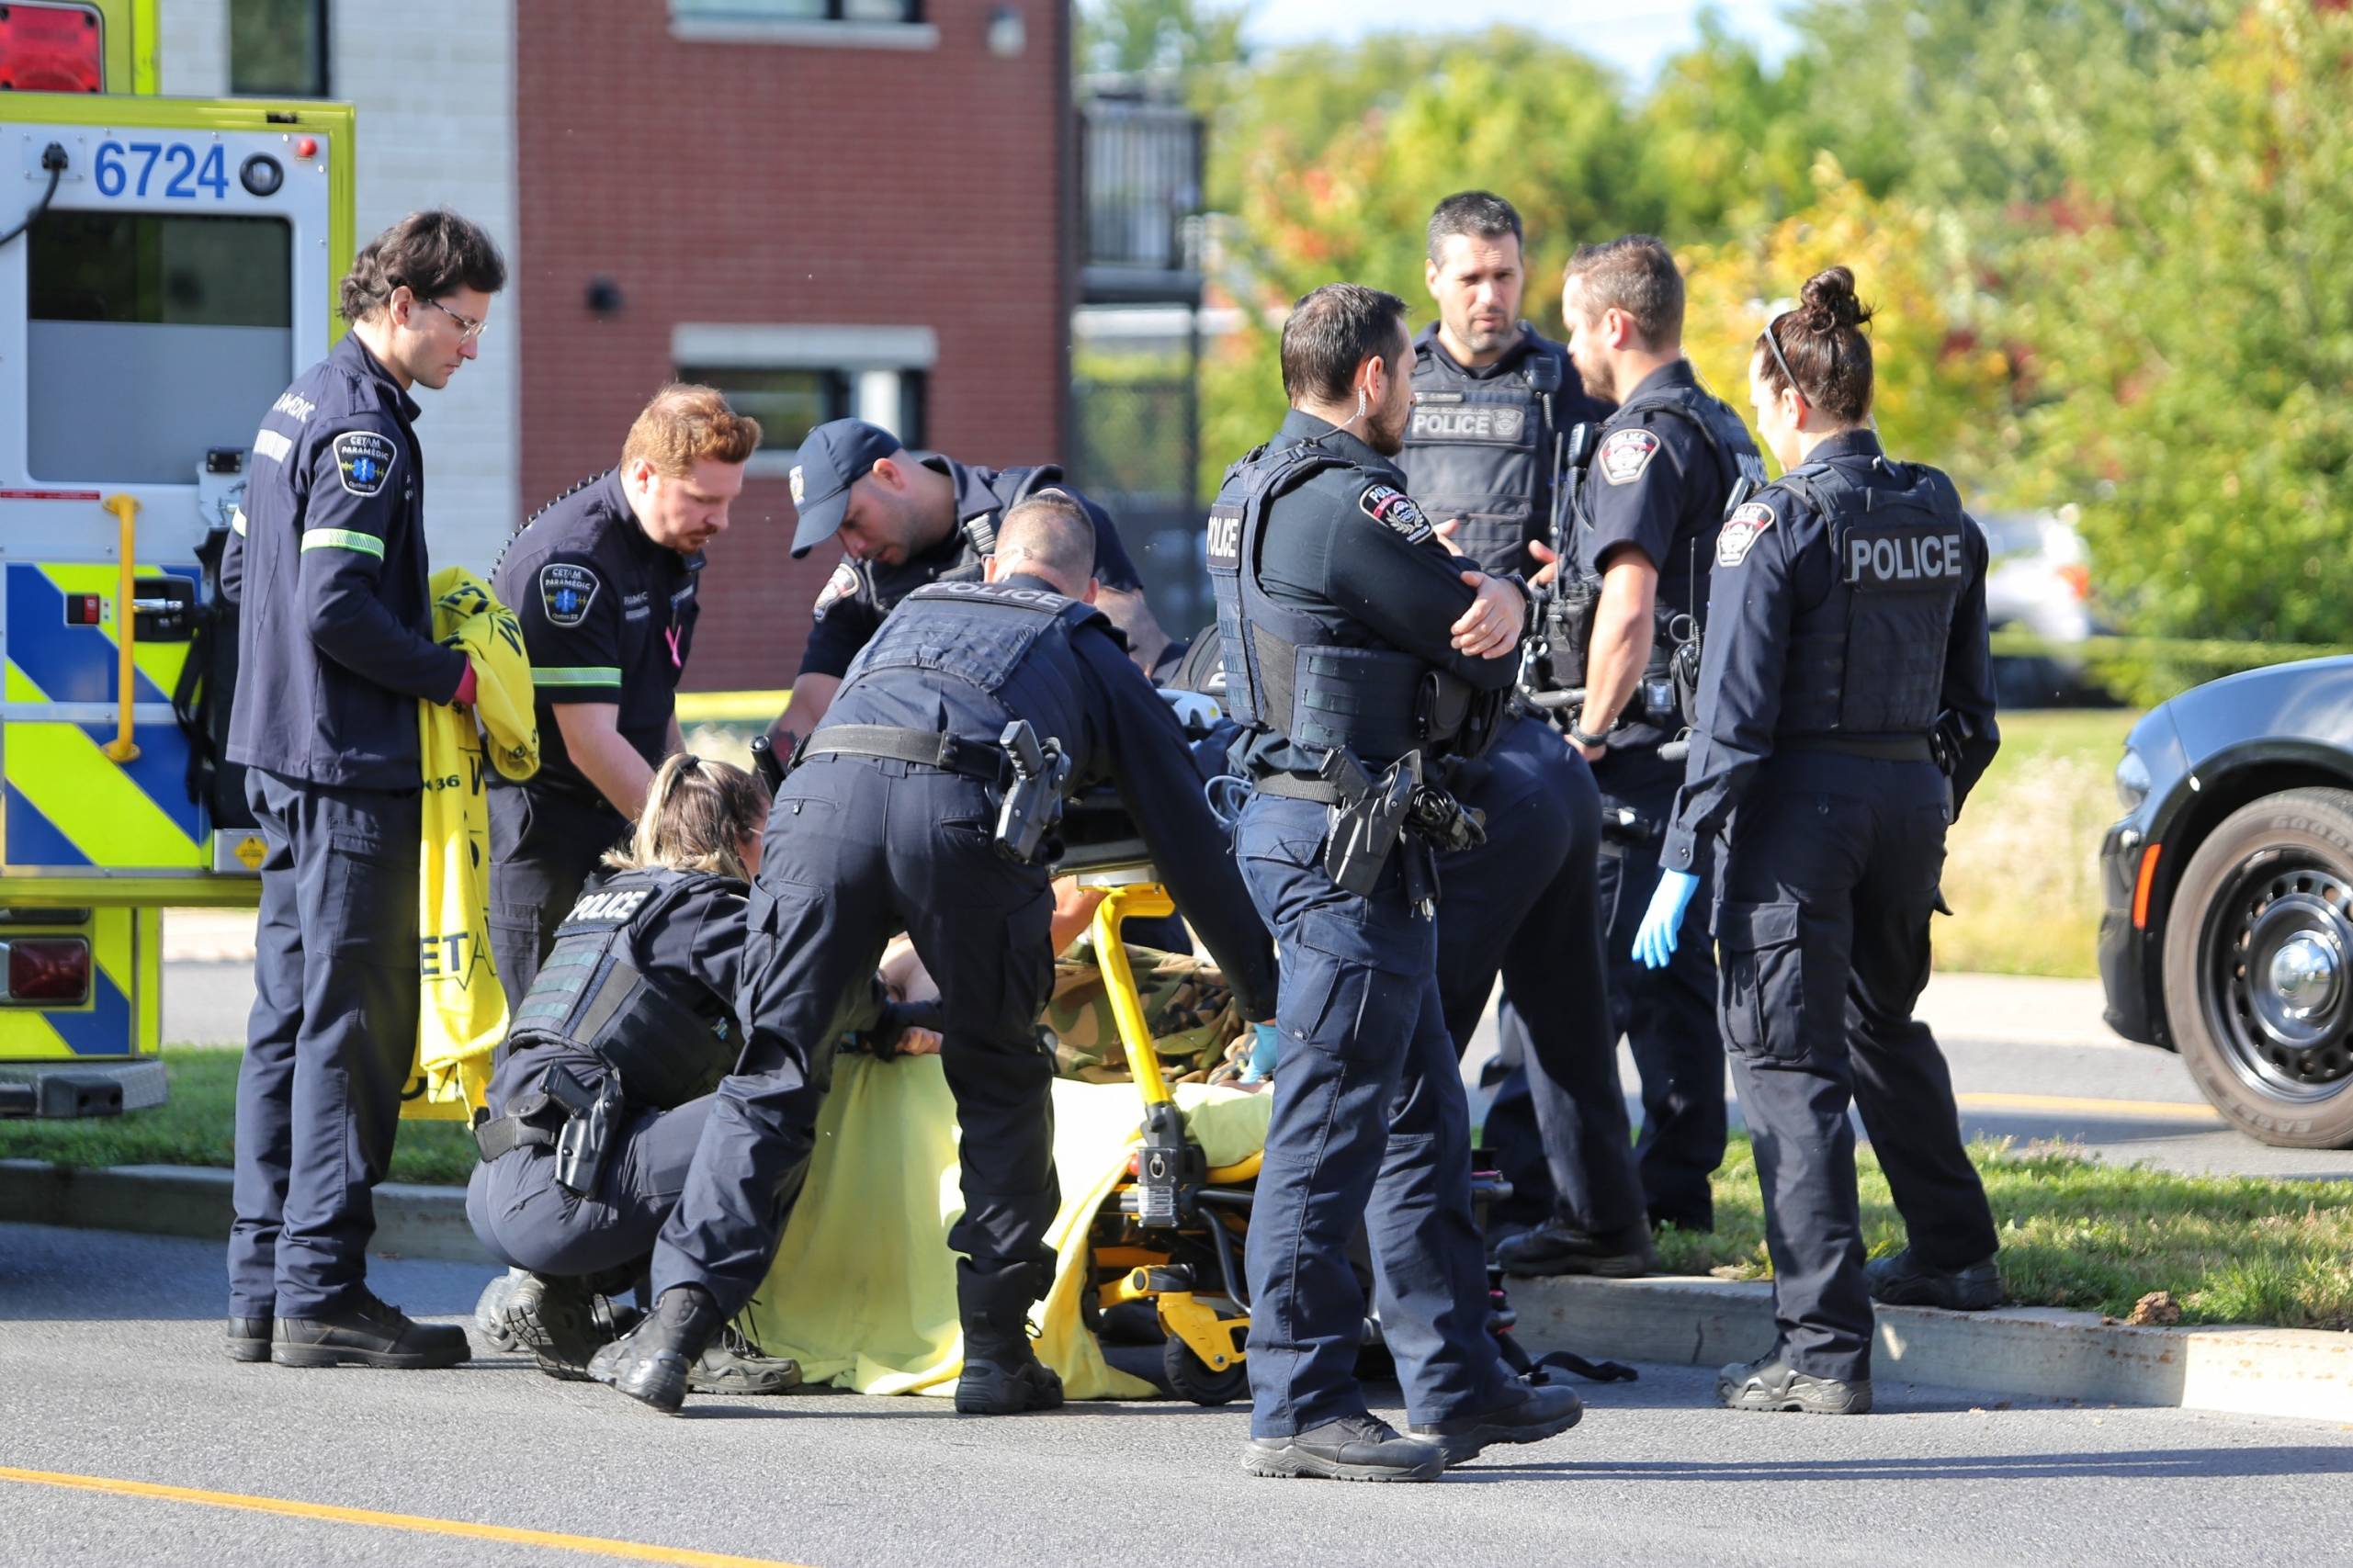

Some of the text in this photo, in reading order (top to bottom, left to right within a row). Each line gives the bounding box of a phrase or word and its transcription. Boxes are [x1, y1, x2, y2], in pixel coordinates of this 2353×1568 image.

[94, 141, 229, 198] 6724
[1412, 413, 1490, 434] POLICE
[350, 435, 381, 448] CETAM
[1206, 516, 1239, 558] POLICE
[1851, 535, 1962, 582] POLICE
[551, 569, 583, 580] CETAM
[919, 581, 1068, 607] POLICE
[564, 890, 649, 922] POLICE
